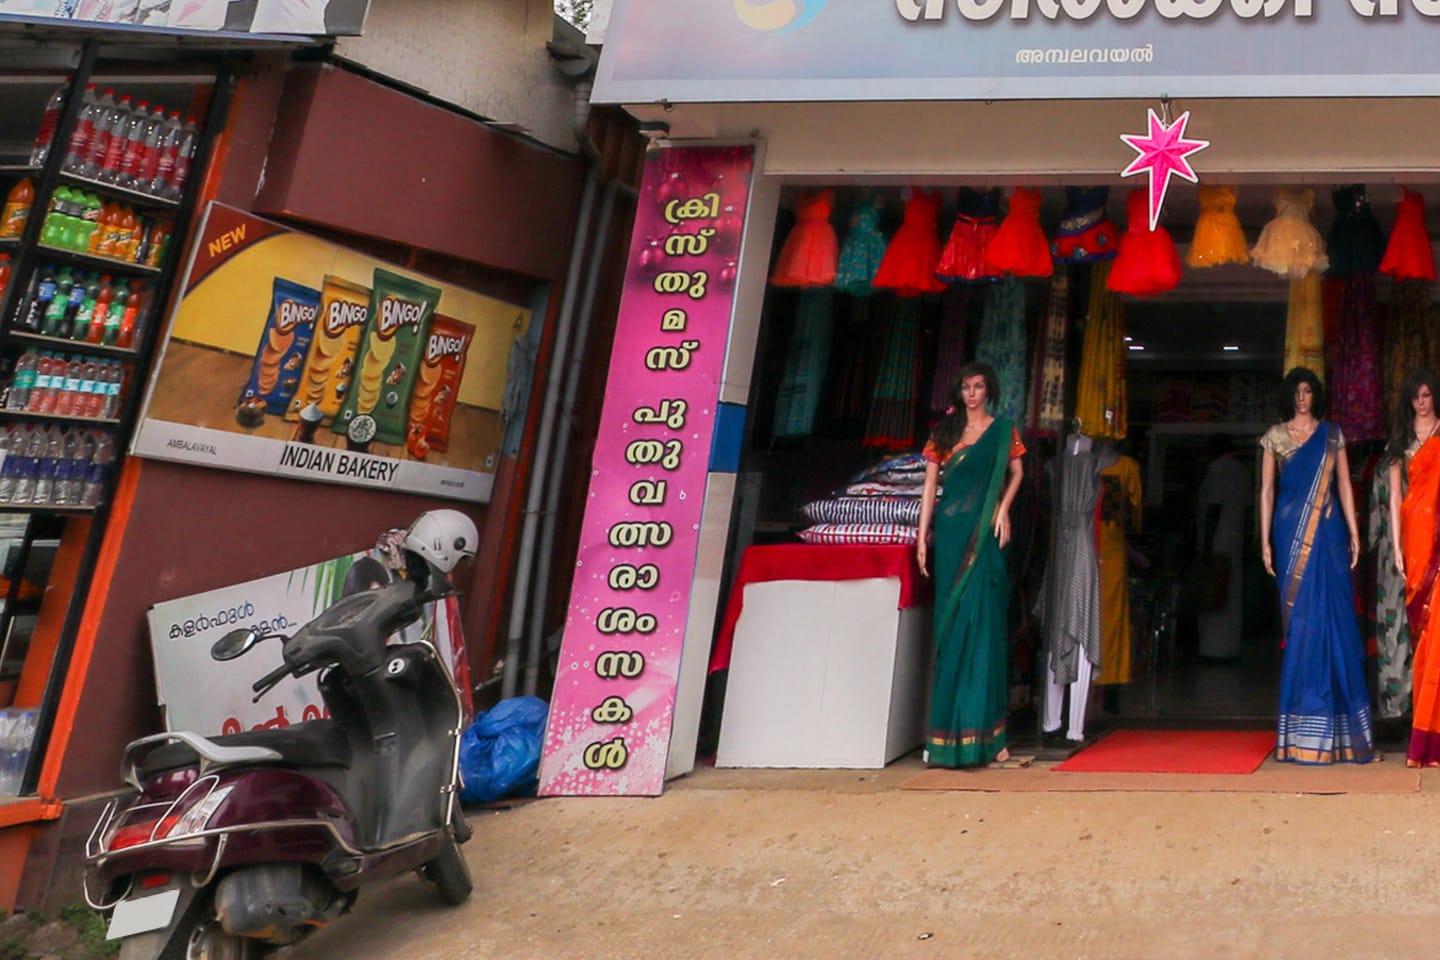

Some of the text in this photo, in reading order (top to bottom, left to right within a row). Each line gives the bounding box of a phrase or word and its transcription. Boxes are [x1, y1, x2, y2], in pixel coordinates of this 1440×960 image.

[1015, 43, 1154, 64] അമ്പലവയൽ
[208, 223, 248, 258] NEW
[381, 299, 427, 333] BINGO!
[428, 334, 466, 361] BINGO!
[167, 438, 217, 456] AMBALAVAYAL
[279, 444, 400, 482] INDIAN BAKERY
